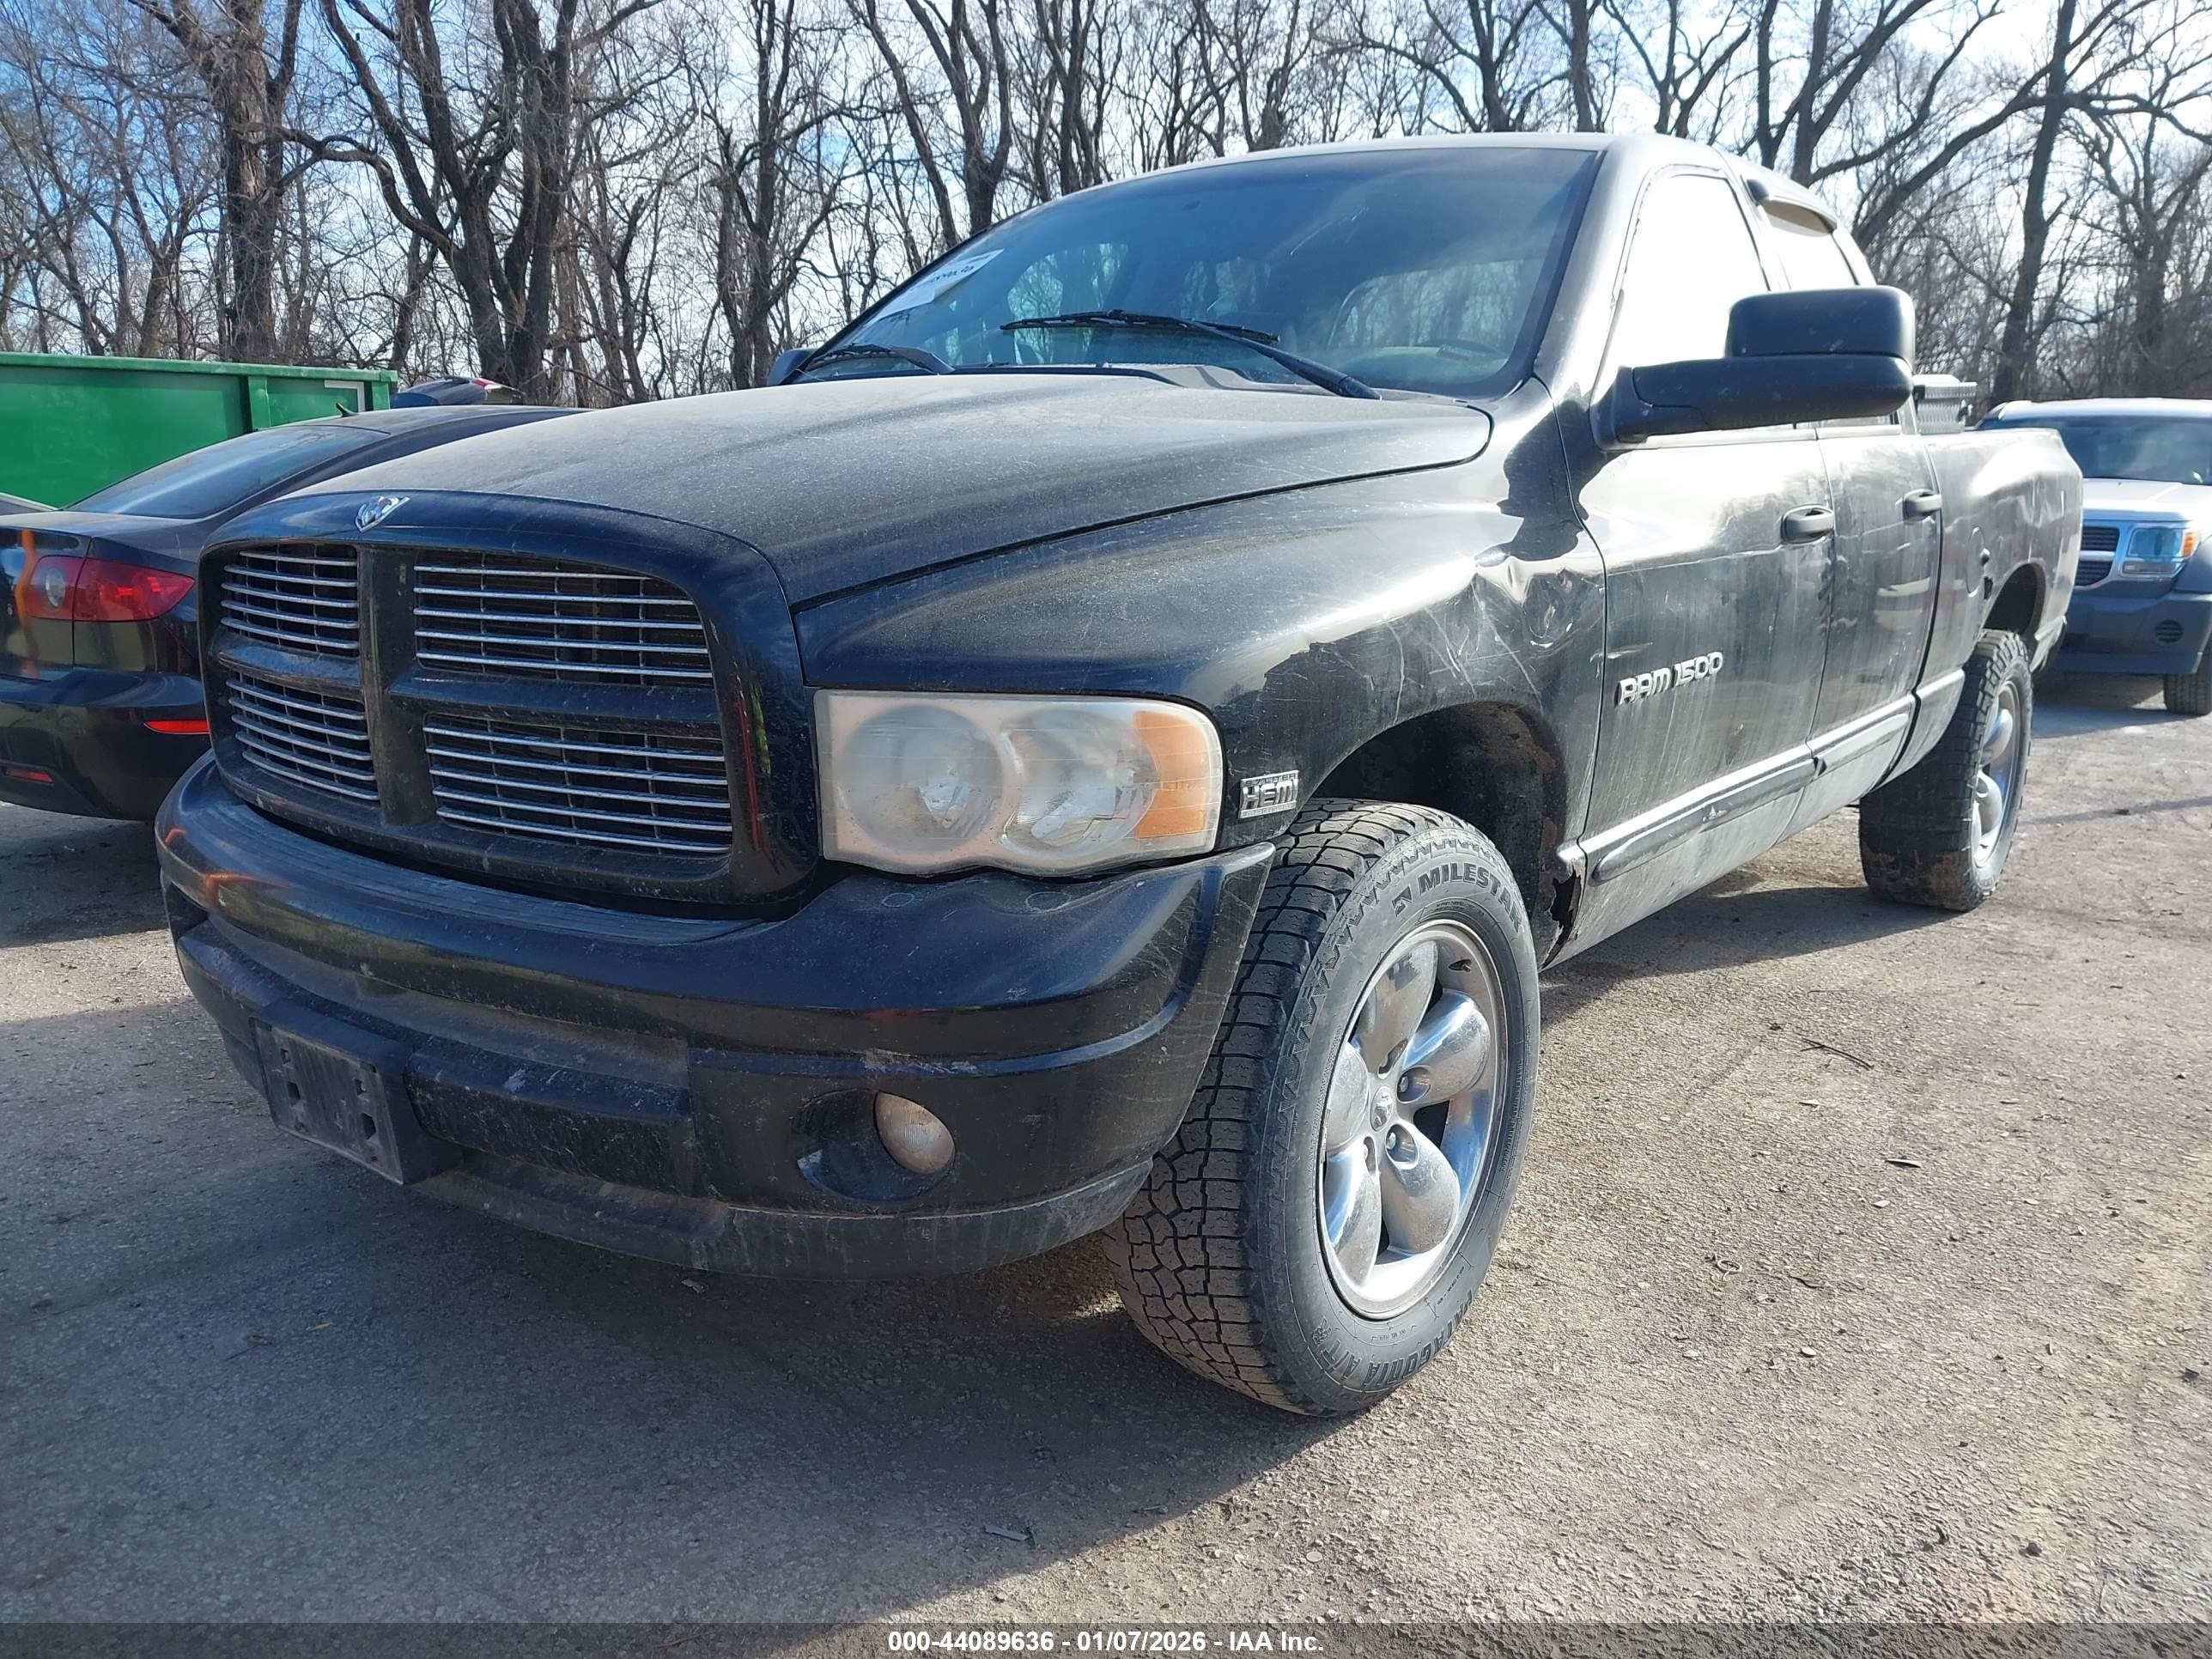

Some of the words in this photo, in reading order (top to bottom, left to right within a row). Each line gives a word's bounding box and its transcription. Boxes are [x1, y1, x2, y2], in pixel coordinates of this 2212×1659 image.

[1618, 667, 1671, 706] RAM
[1674, 651, 1723, 688] 1500
[1242, 779, 1298, 810] HEMI
[1418, 862, 1520, 933] MILESTAR
